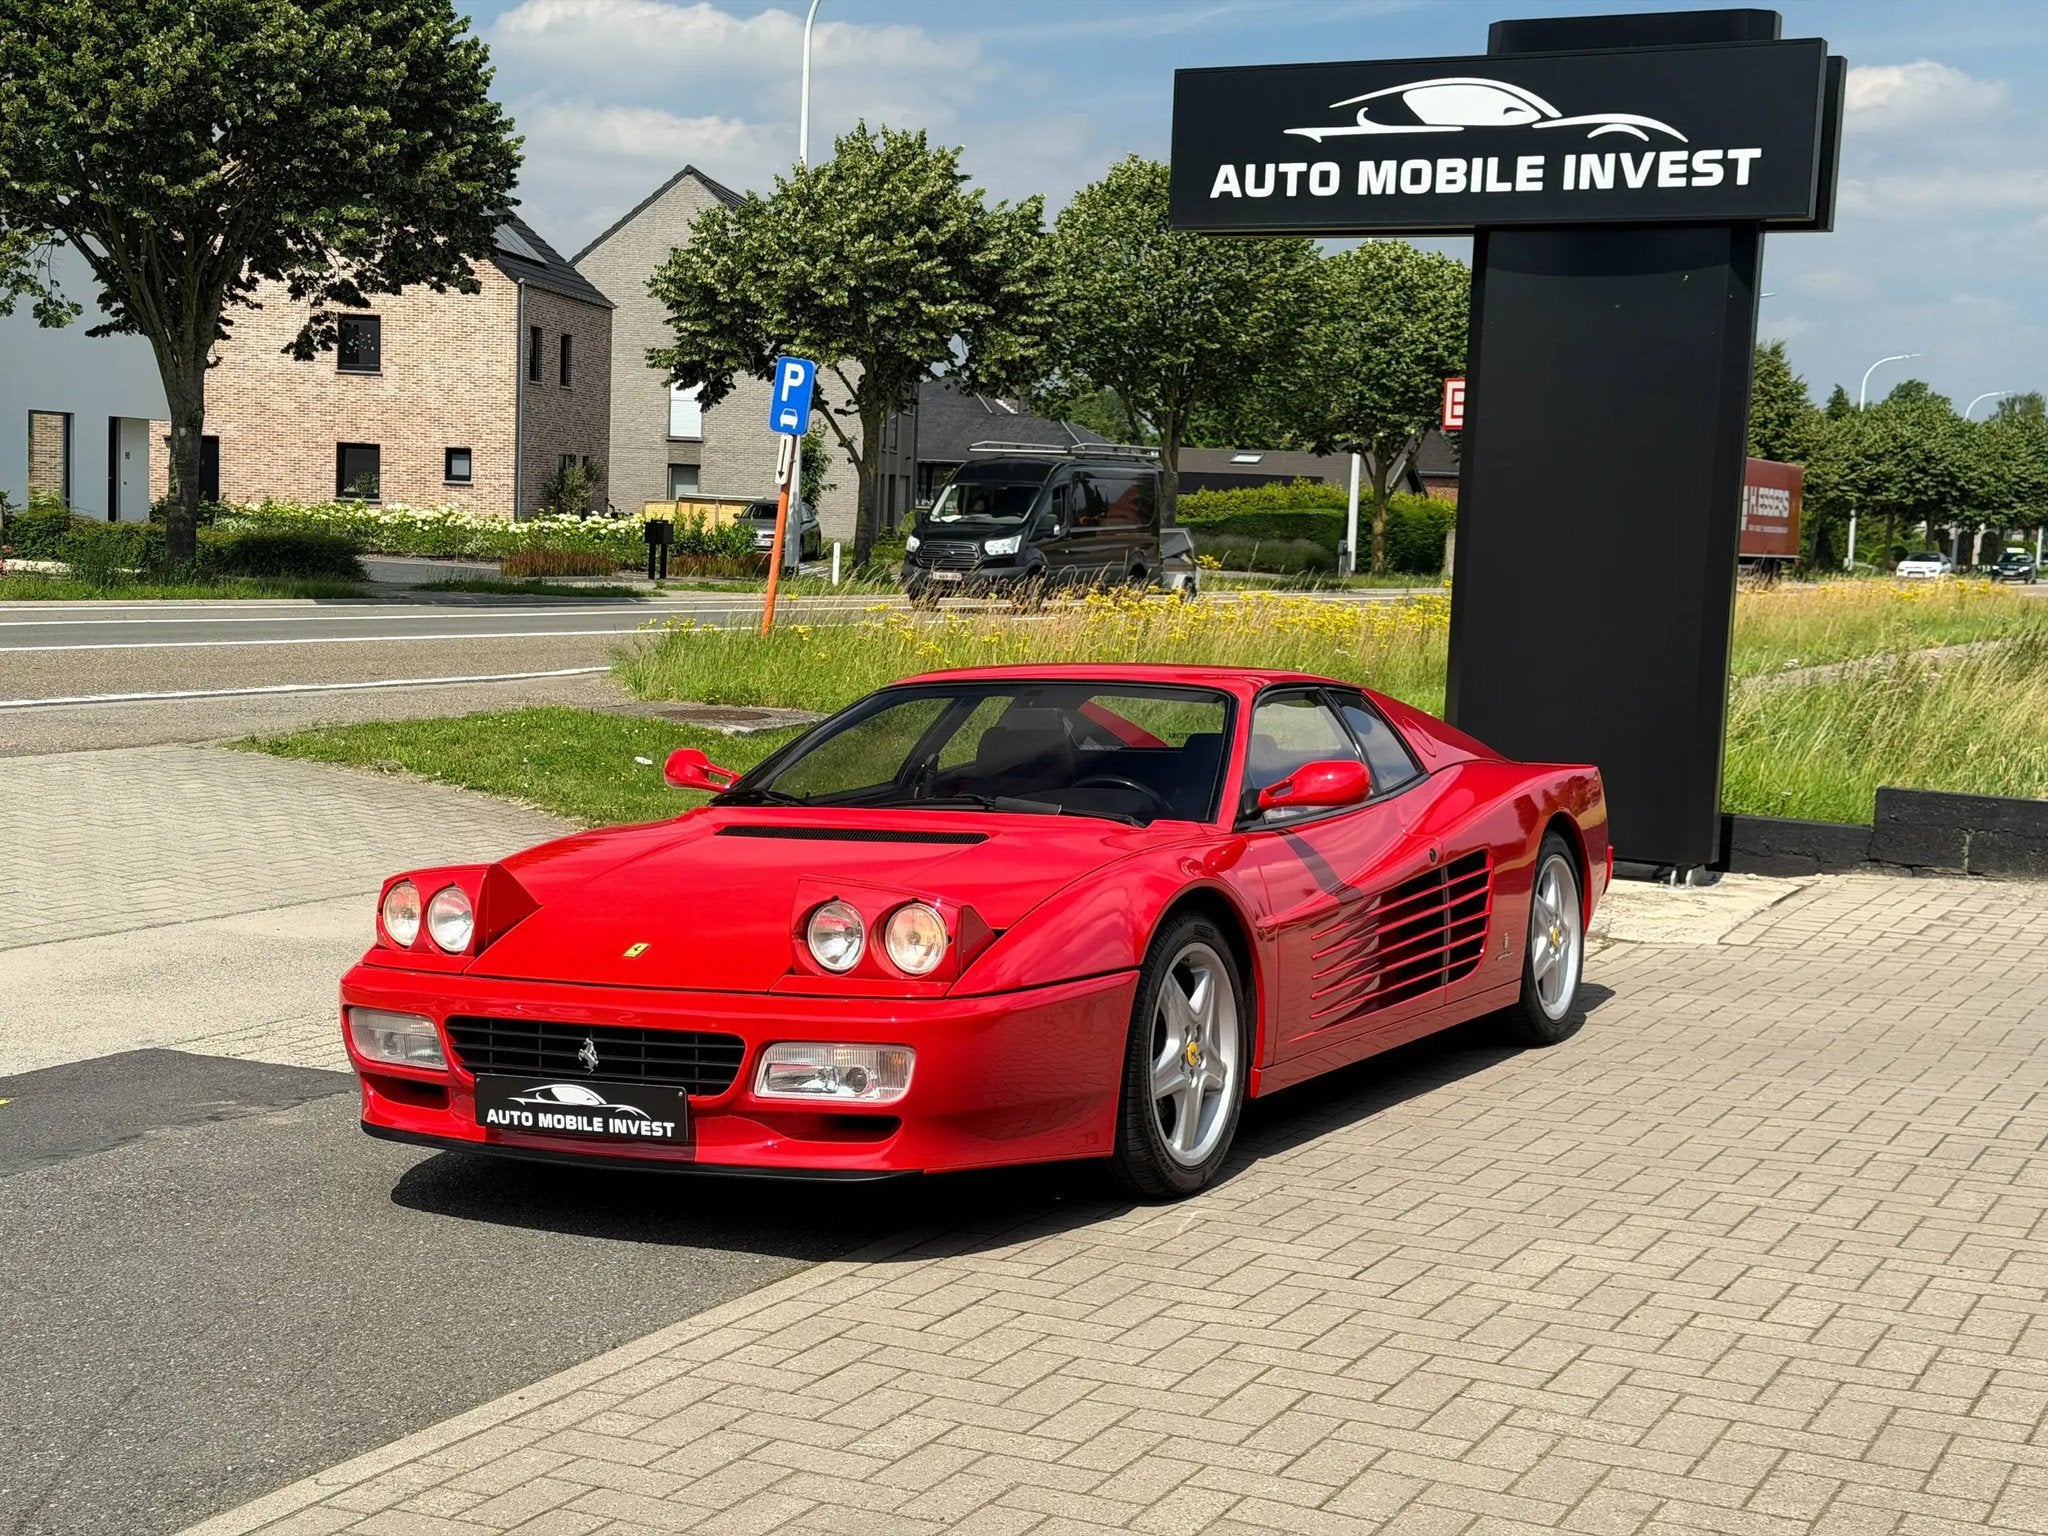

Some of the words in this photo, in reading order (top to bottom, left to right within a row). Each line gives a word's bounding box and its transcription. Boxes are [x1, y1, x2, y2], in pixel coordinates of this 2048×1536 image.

[1209, 161, 1341, 199] AUTO
[1357, 155, 1545, 196] MOBILE
[1562, 147, 1762, 191] INVEST
[781, 362, 805, 402] P
[486, 1108, 533, 1127] AUTO
[538, 1112, 604, 1133] MOBILE
[608, 1117, 675, 1138] INVEST
